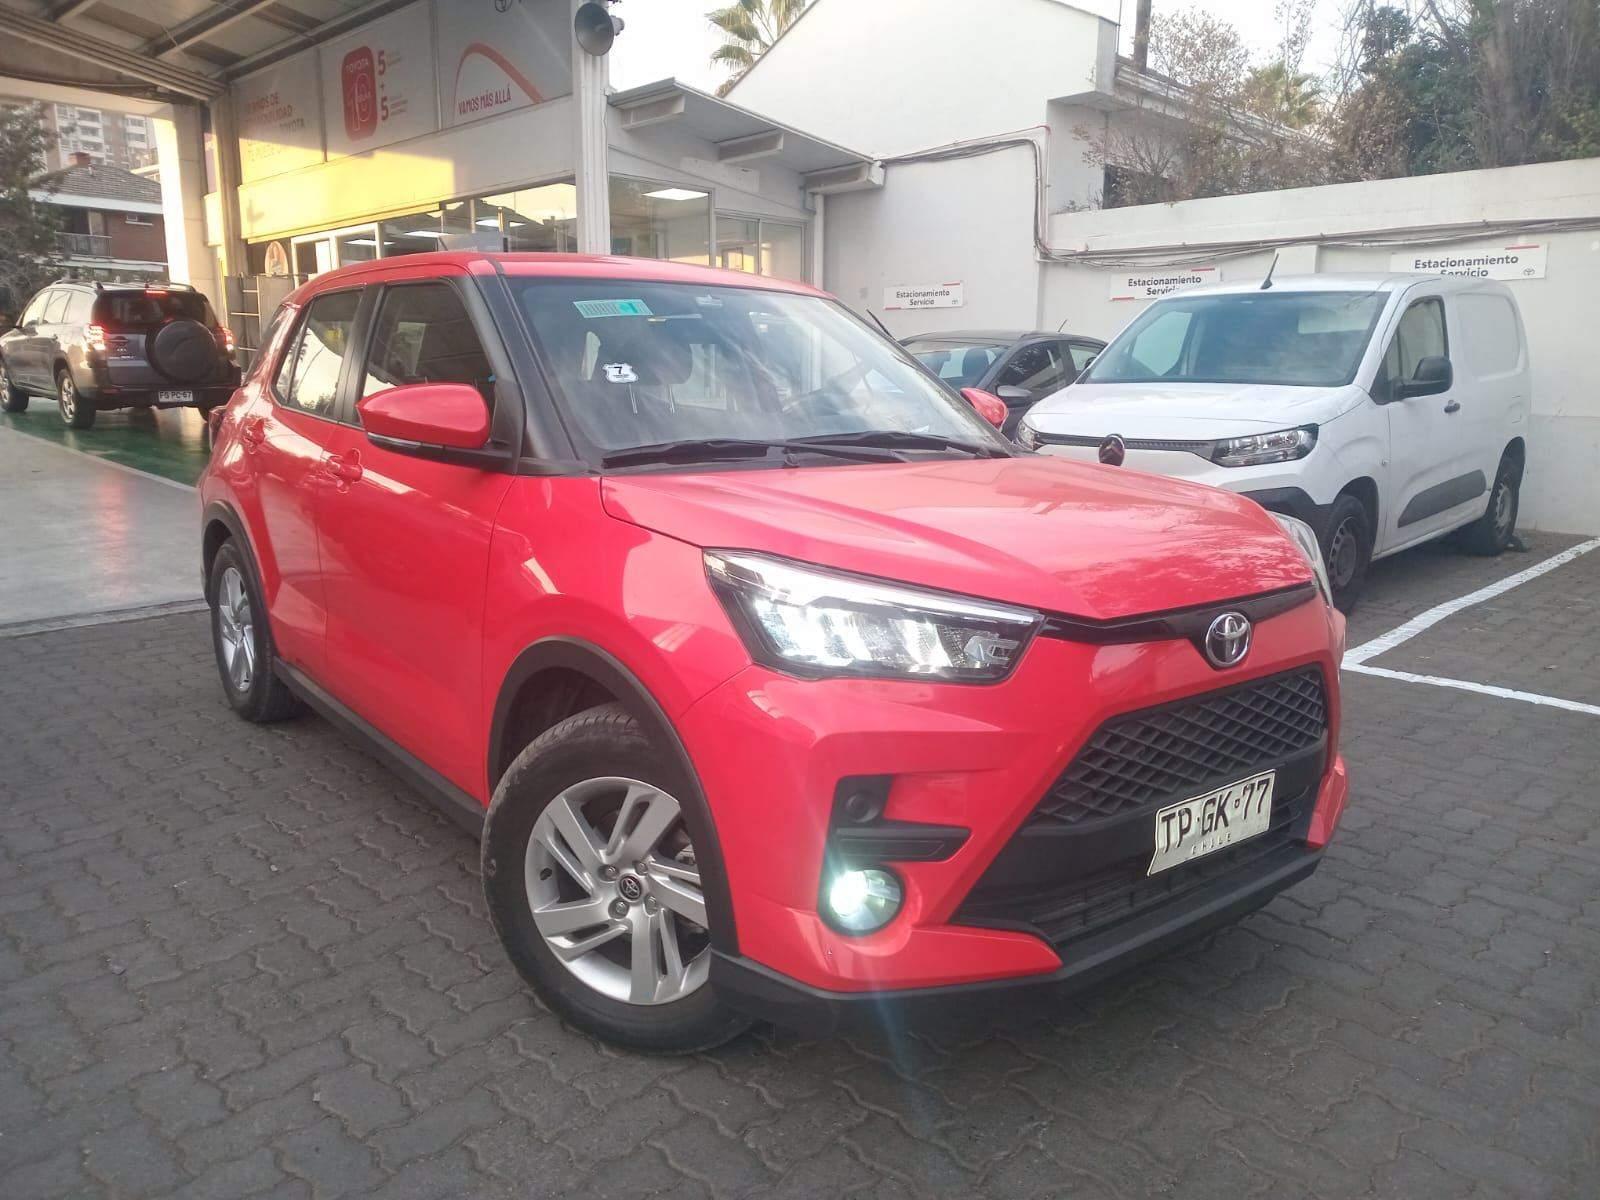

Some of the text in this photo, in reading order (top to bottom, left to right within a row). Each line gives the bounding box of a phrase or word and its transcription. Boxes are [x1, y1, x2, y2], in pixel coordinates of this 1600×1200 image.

[458, 96, 479, 115] VAMOS
[1414, 255, 1519, 269] Estacionamiento
[1128, 275, 1202, 287] Estacionamiento
[896, 289, 950, 299] Estacionamiento
[1146, 286, 1180, 296] Servi
[910, 298, 935, 306] Servicio
[1191, 832, 1232, 855] CHILE
